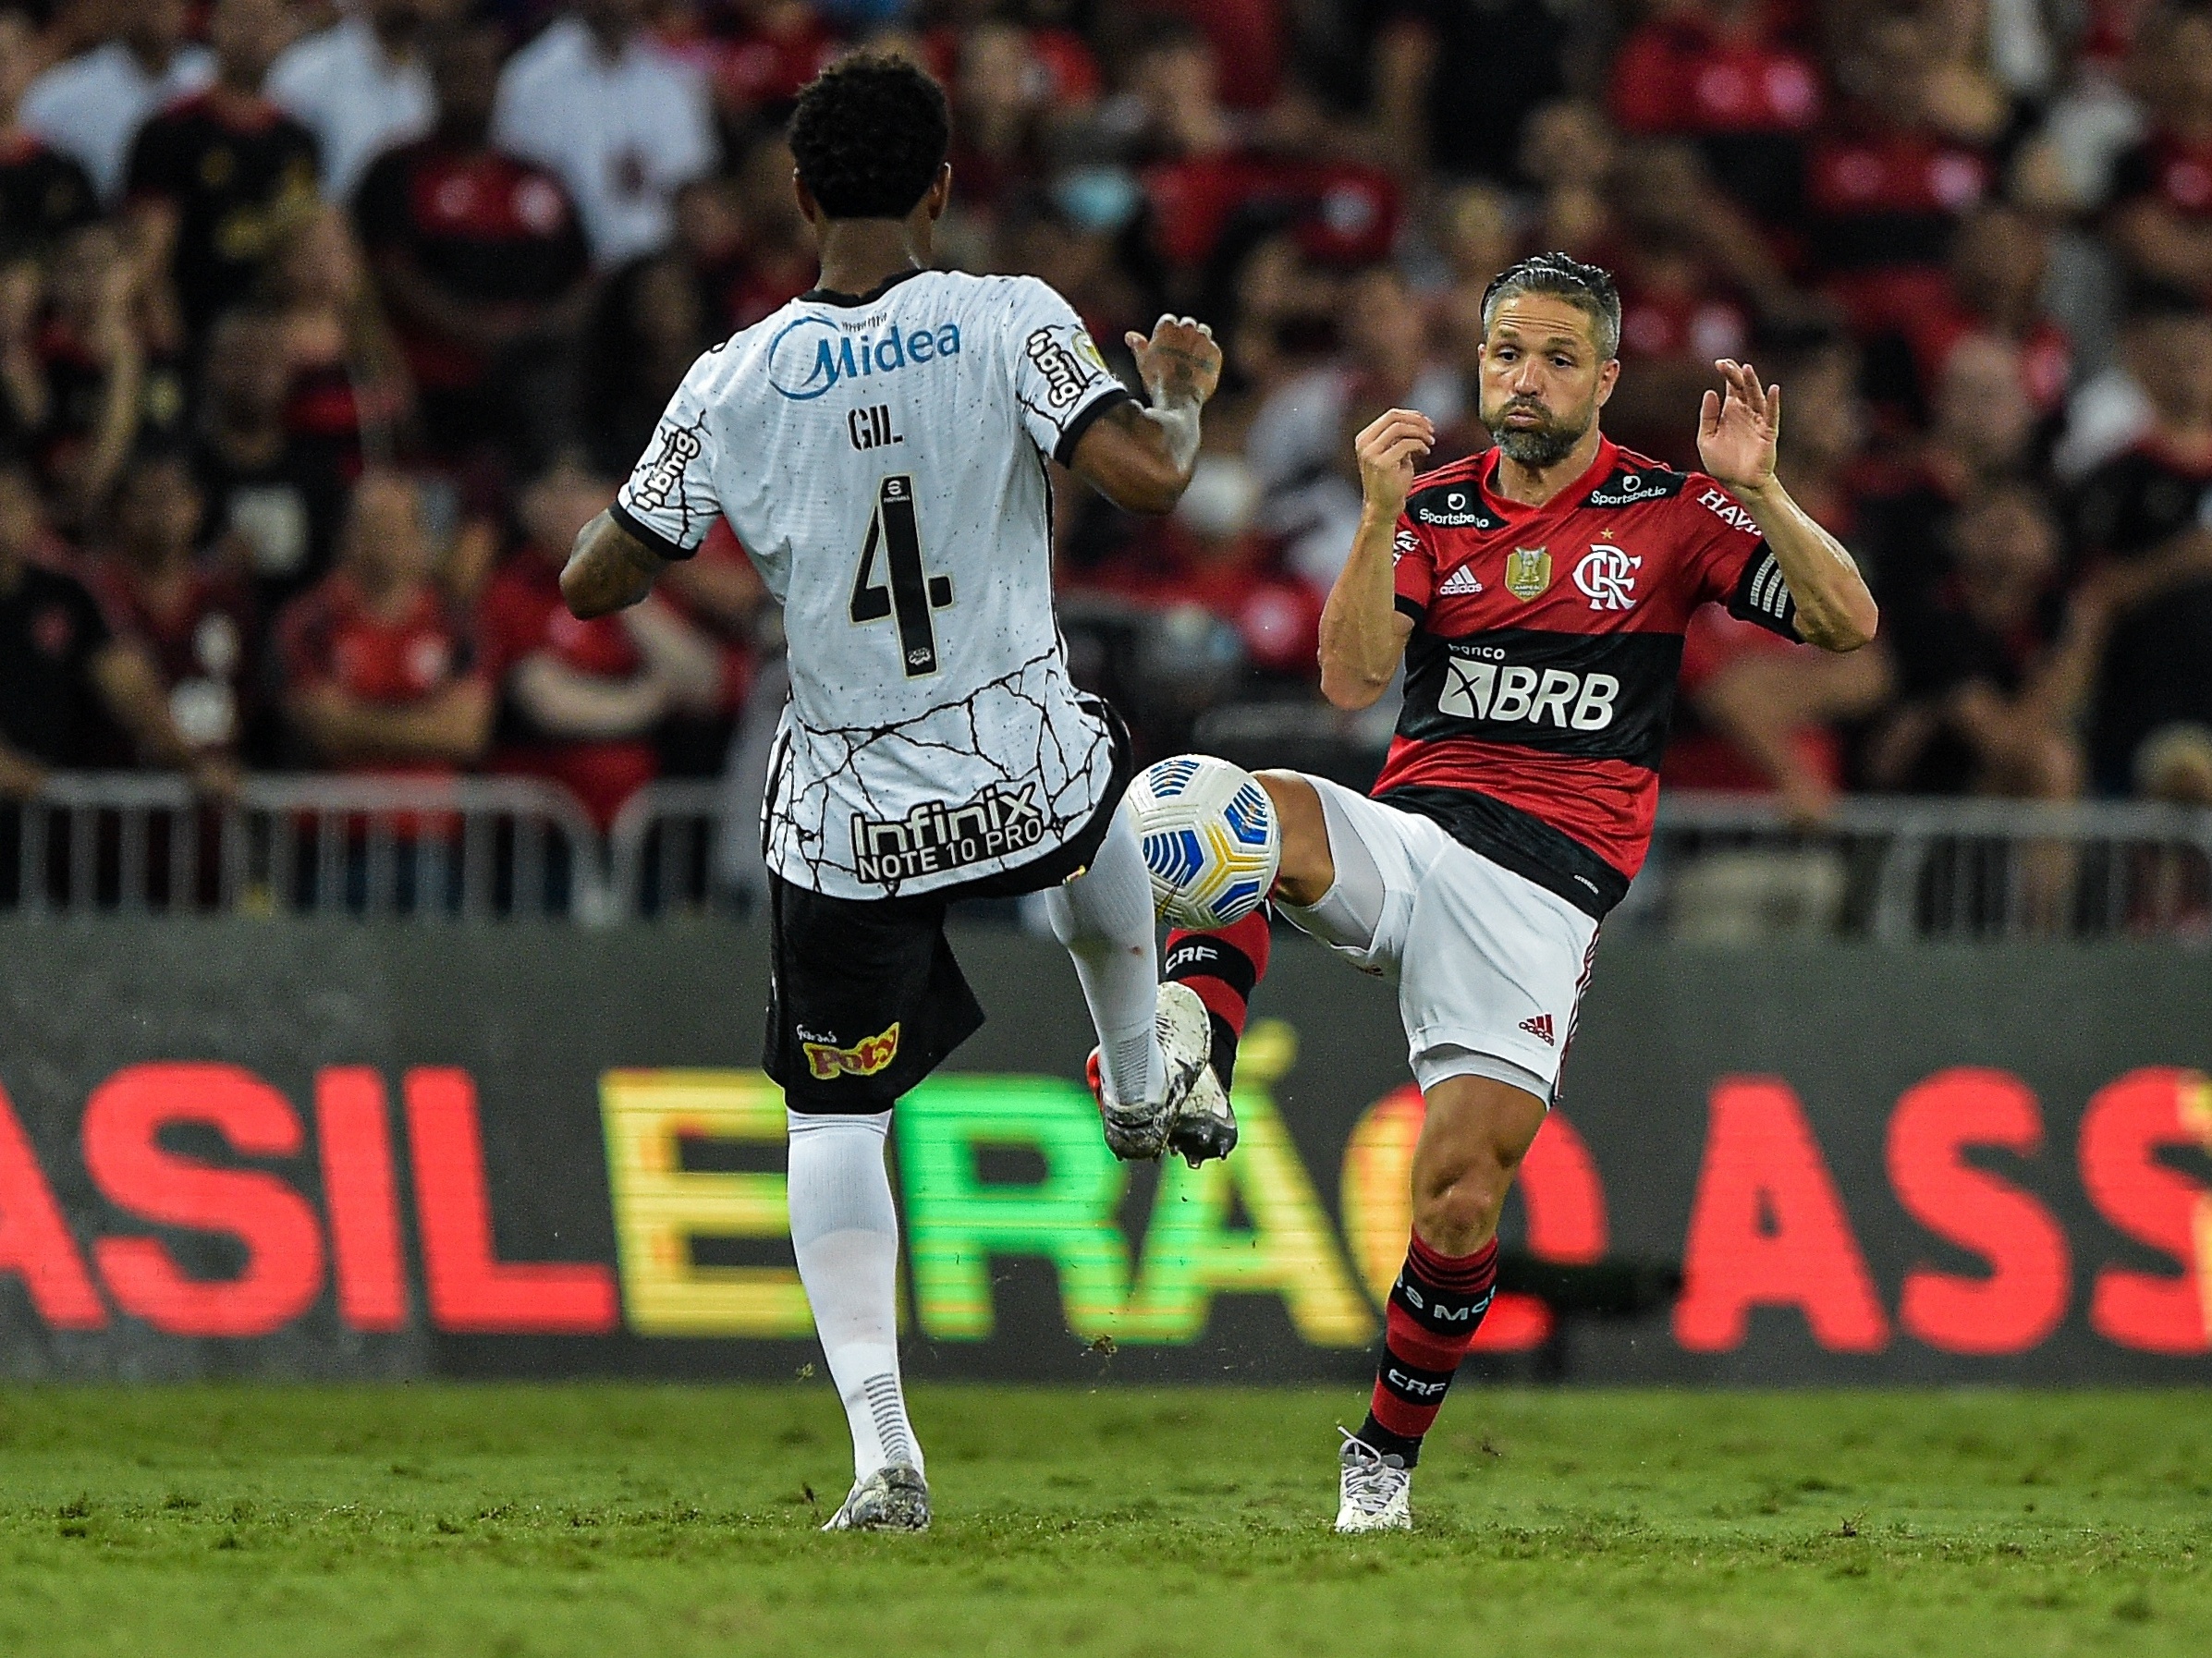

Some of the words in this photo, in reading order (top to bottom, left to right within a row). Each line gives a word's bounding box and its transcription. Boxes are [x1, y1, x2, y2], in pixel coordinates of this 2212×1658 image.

[800, 323, 960, 387] Midea
[847, 404, 904, 451] GIL
[1419, 507, 1489, 529] Sportsbeio
[1695, 487, 1763, 537] HAV
[849, 475, 953, 677] 4
[1439, 583, 1483, 595] adidas
[1448, 643, 1506, 660] banco
[1489, 665, 1619, 731] BRB
[853, 784, 1041, 857] Infinix
[858, 846, 939, 882] NOTE
[945, 838, 977, 866] 10
[984, 817, 1044, 856] PRO
[1165, 945, 1218, 974] CRF
[805, 1024, 899, 1077] Poty
[1518, 1021, 1555, 1047] adidas
[1387, 1368, 1447, 1396] CRF
